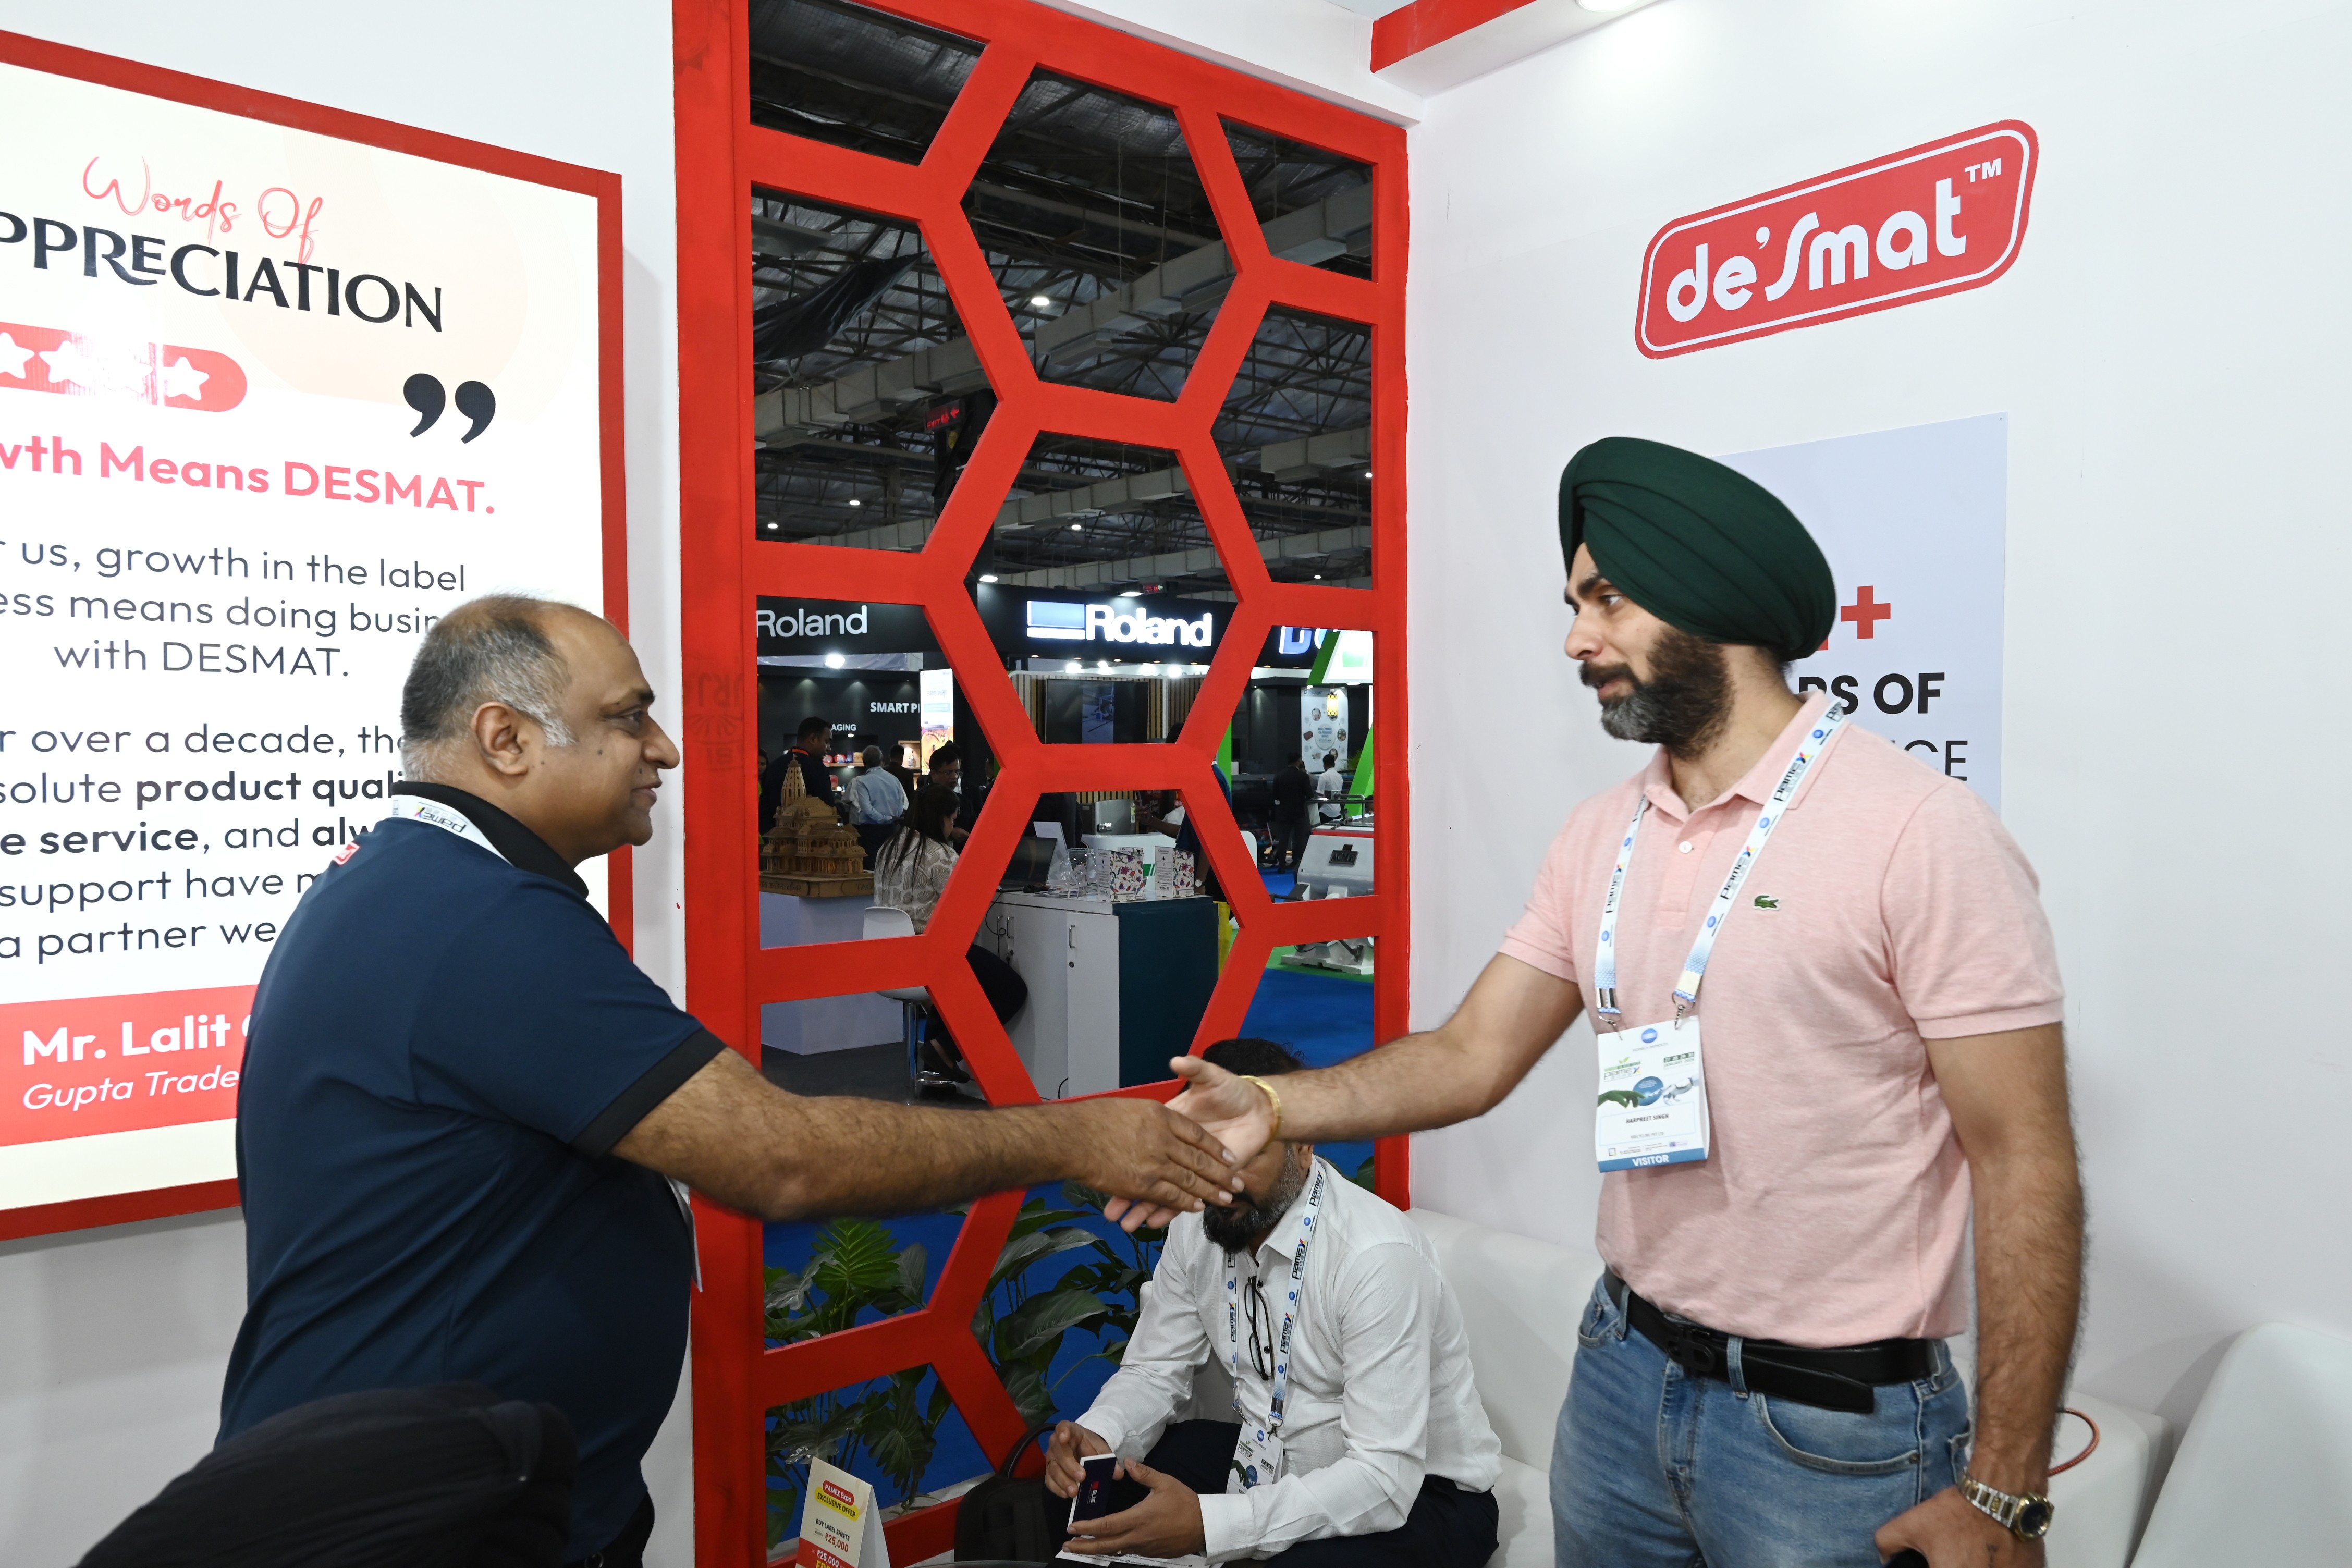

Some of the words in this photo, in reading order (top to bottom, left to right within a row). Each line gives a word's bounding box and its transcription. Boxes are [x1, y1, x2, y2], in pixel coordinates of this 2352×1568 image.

[82, 155, 242, 243] Words
[258, 187, 323, 271] Of
[101, 442, 269, 493] Means
[285, 461, 494, 514] DESMAT.
[23, 543, 79, 571] us,
[97, 548, 248, 577] growth
[264, 552, 292, 580] in
[307, 555, 367, 584] the
[381, 559, 463, 591] label
[71, 597, 212, 623] means
[227, 597, 335, 637] doing
[757, 605, 867, 637] Roland
[1085, 604, 1212, 647] Roland
[54, 640, 145, 669] with
[164, 642, 348, 676] DESMAT.
[870, 702, 909, 713] SMART
[1873, 672, 1945, 715] OF
[32, 731, 131, 752] over
[146, 732, 168, 752] a
[185, 724, 344, 757] decade,
[137, 771, 301, 810] product
[40, 822, 209, 854] service,
[225, 818, 298, 848] and
[187, 869, 283, 898] have
[39, 923, 206, 964] partner
[24, 1027, 106, 1065] Mr.
[123, 1014, 230, 1056] Lalit
[23, 1078, 133, 1111] Gupta
[1626, 1116, 1652, 1124] HARPREET
[1632, 1154, 1669, 1167] VISITOR
[817, 1492, 841, 1510] EXCLUSIVE
[842, 1506, 855, 1518] OFFER
[825, 1484, 841, 1497] PAMEX
[841, 1492, 852, 1503] Expo
[816, 1518, 824, 1527] BUY
[825, 1523, 836, 1533] LABEL
[836, 1529, 850, 1541] SHEETS
